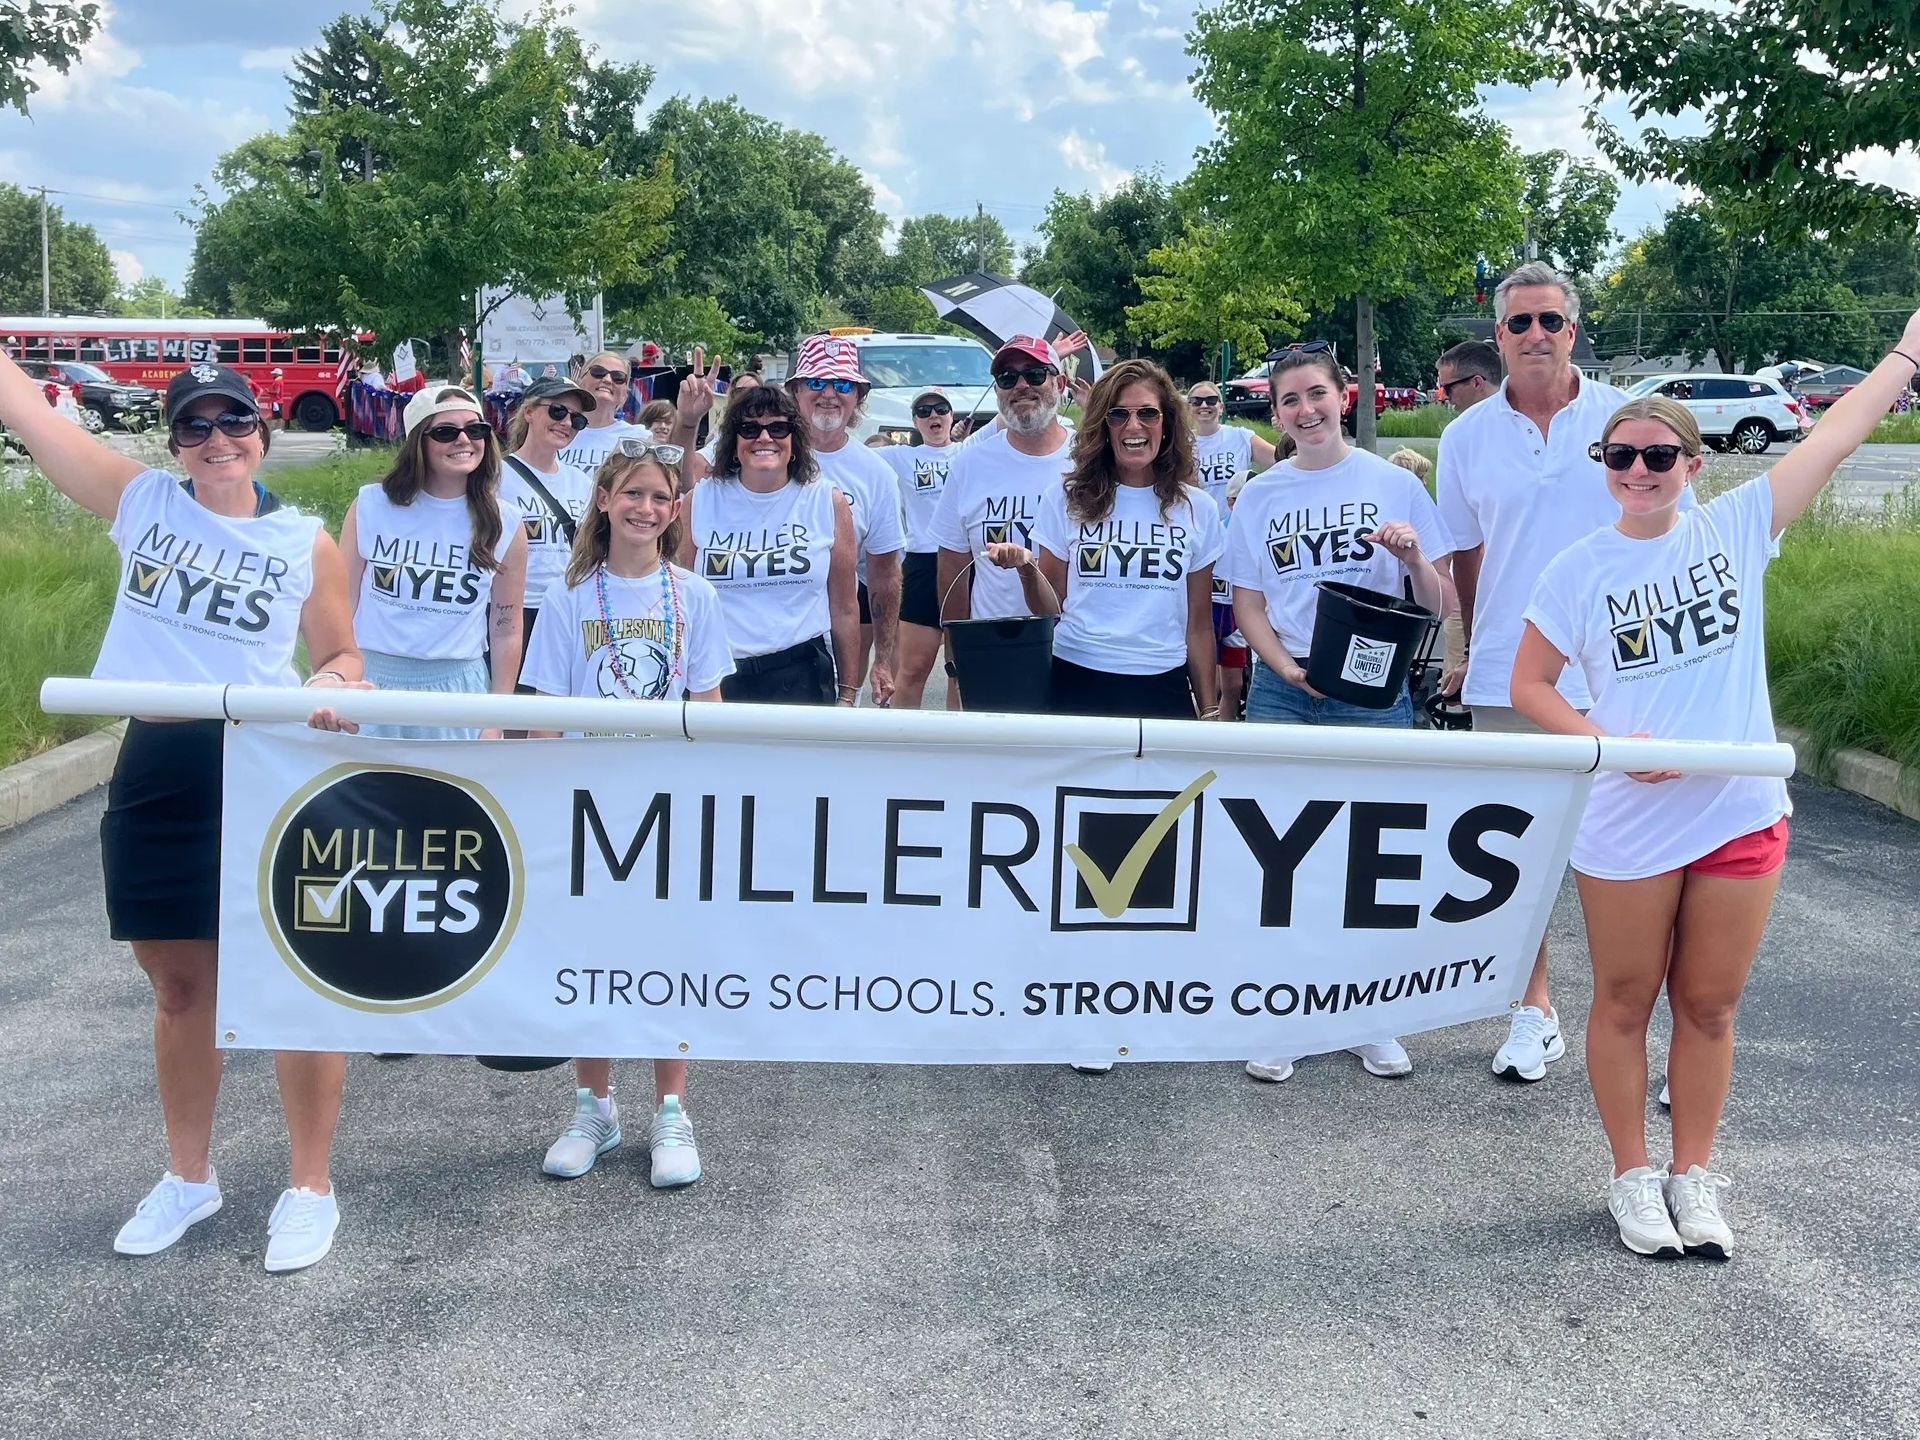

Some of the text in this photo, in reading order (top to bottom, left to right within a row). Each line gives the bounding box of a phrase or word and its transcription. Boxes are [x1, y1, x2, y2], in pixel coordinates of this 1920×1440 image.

[104, 339, 221, 363] LIFEWISE
[142, 369, 182, 379] ACADEM
[1200, 464, 1236, 482] YES
[709, 523, 810, 552] MILLER
[1080, 520, 1187, 549] MILLER
[1268, 502, 1378, 539] MILLER
[136, 523, 288, 592] MILLER
[738, 545, 811, 578] YES
[1110, 544, 1183, 581] YES
[1300, 527, 1375, 567] YES
[175, 568, 275, 632] YES
[405, 566, 481, 605] YES
[1606, 552, 1737, 626] MILLER
[416, 606, 442, 614] STRONG
[1653, 589, 1741, 655] YES
[182, 623, 216, 637] STRONG
[1354, 659, 1382, 674] UNITED
[1616, 672, 1644, 684] STRONG
[301, 828, 482, 872] MILLER
[569, 788, 1041, 913] MILLER
[1218, 797, 1535, 929] YES
[355, 878, 480, 934] YES
[554, 955, 1498, 1017] STRONG SCHOOLS. STRONG COMMUNITY.
